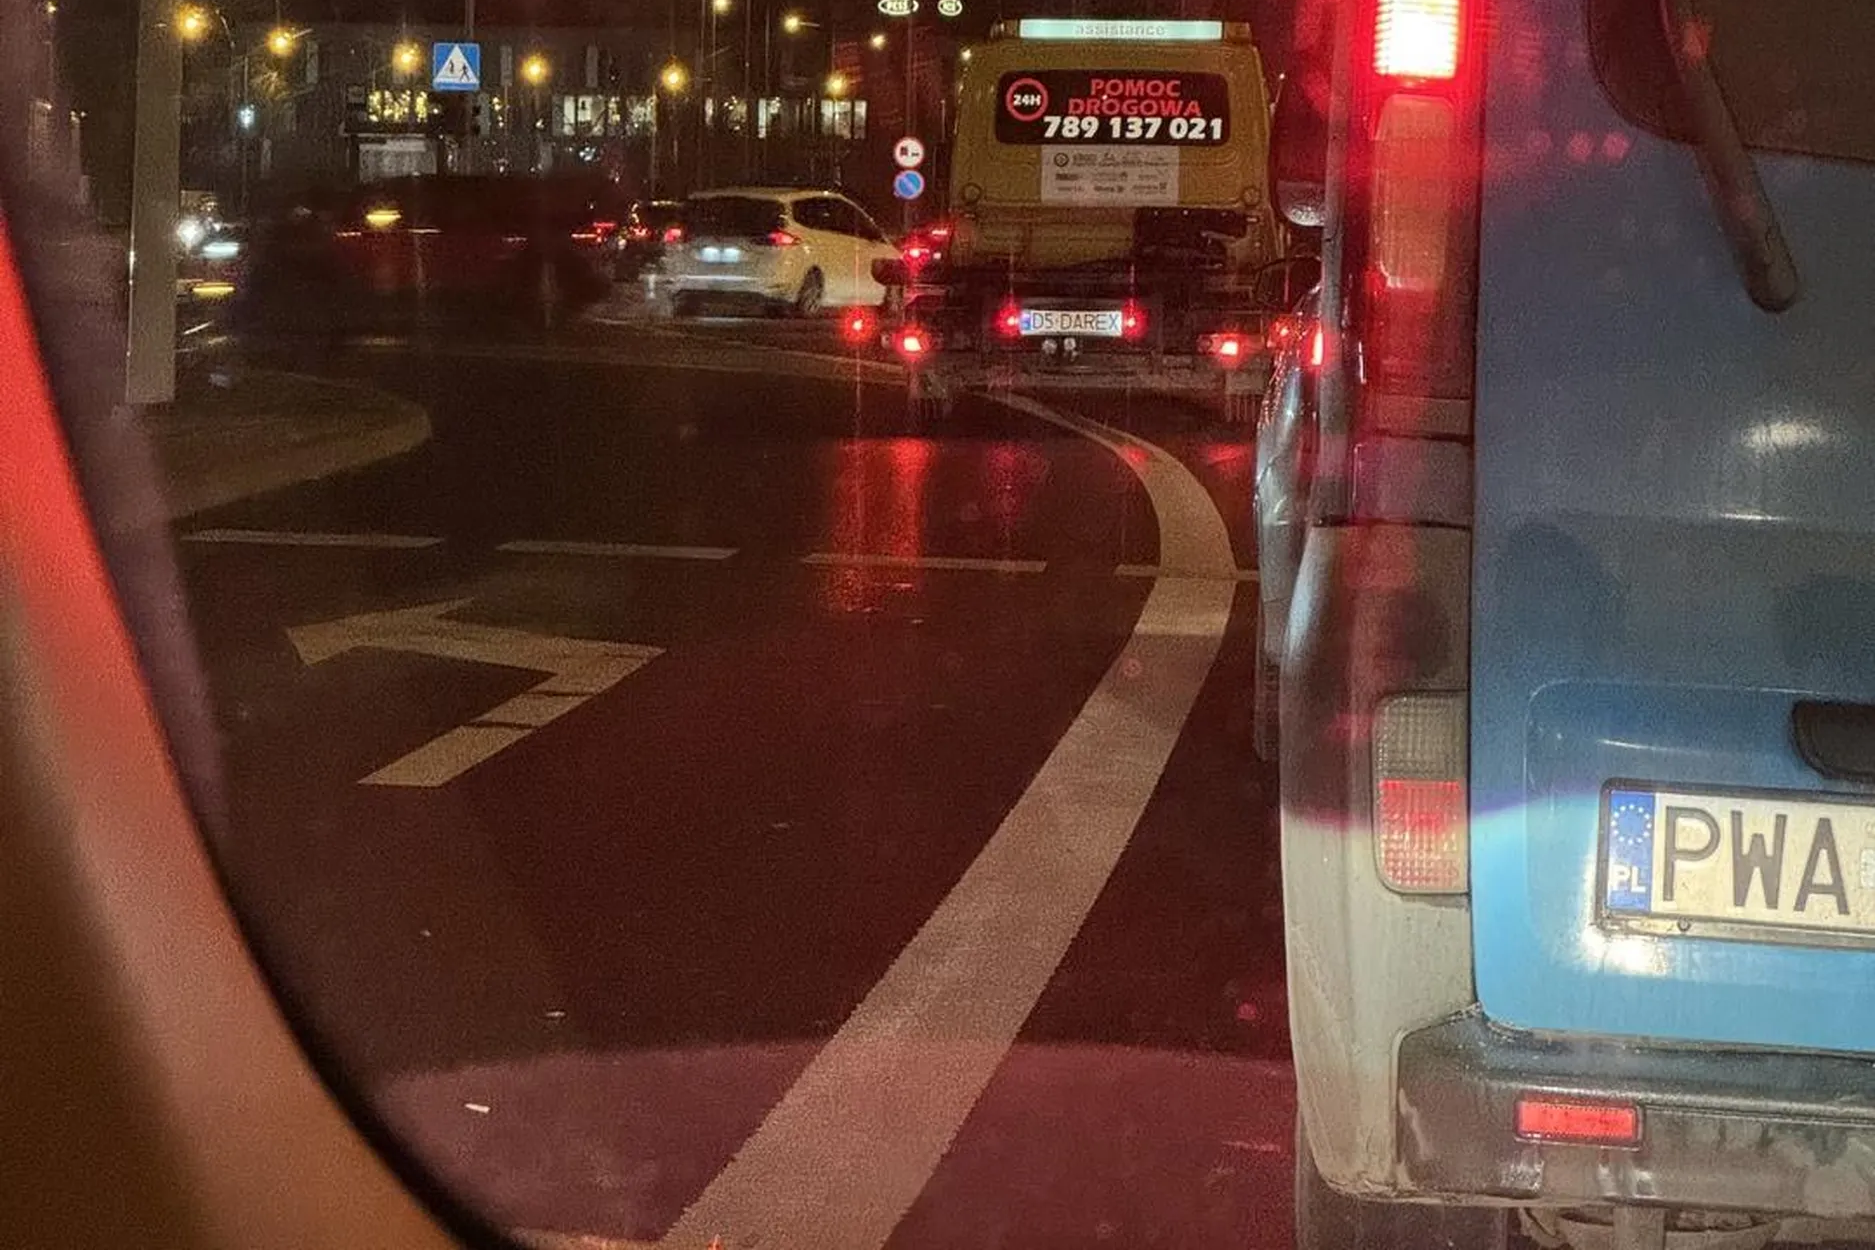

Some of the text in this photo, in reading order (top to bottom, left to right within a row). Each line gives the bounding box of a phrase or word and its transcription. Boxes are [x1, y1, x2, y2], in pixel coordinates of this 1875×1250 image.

[1074, 24, 1166, 37] assistance
[1091, 78, 1181, 97] POMOC
[1012, 93, 1042, 107] 24H
[1068, 98, 1202, 116] DROGOWA
[1043, 115, 1223, 140] 789 137 021
[1663, 805, 1851, 916] PWA
[1612, 866, 1647, 893] PL
